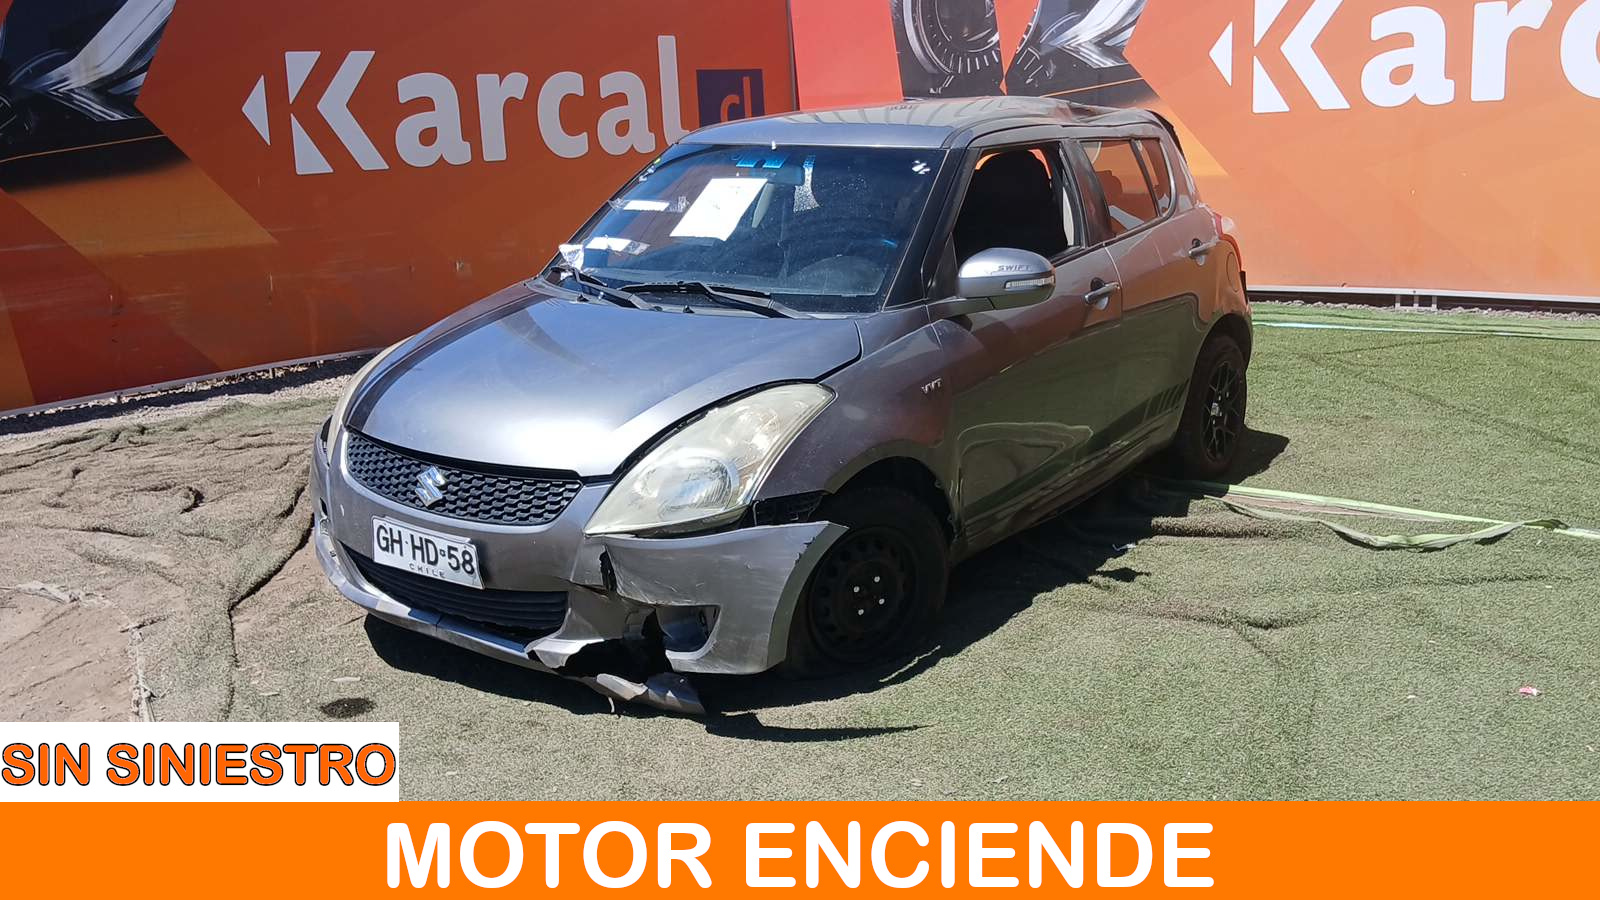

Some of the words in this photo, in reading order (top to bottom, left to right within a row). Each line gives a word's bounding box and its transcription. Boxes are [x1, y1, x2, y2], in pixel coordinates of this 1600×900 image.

[285, 35, 690, 175] Karcal
[997, 264, 1032, 272] SWIFT
[921, 378, 942, 394] VVT
[409, 563, 446, 578] CHILE
